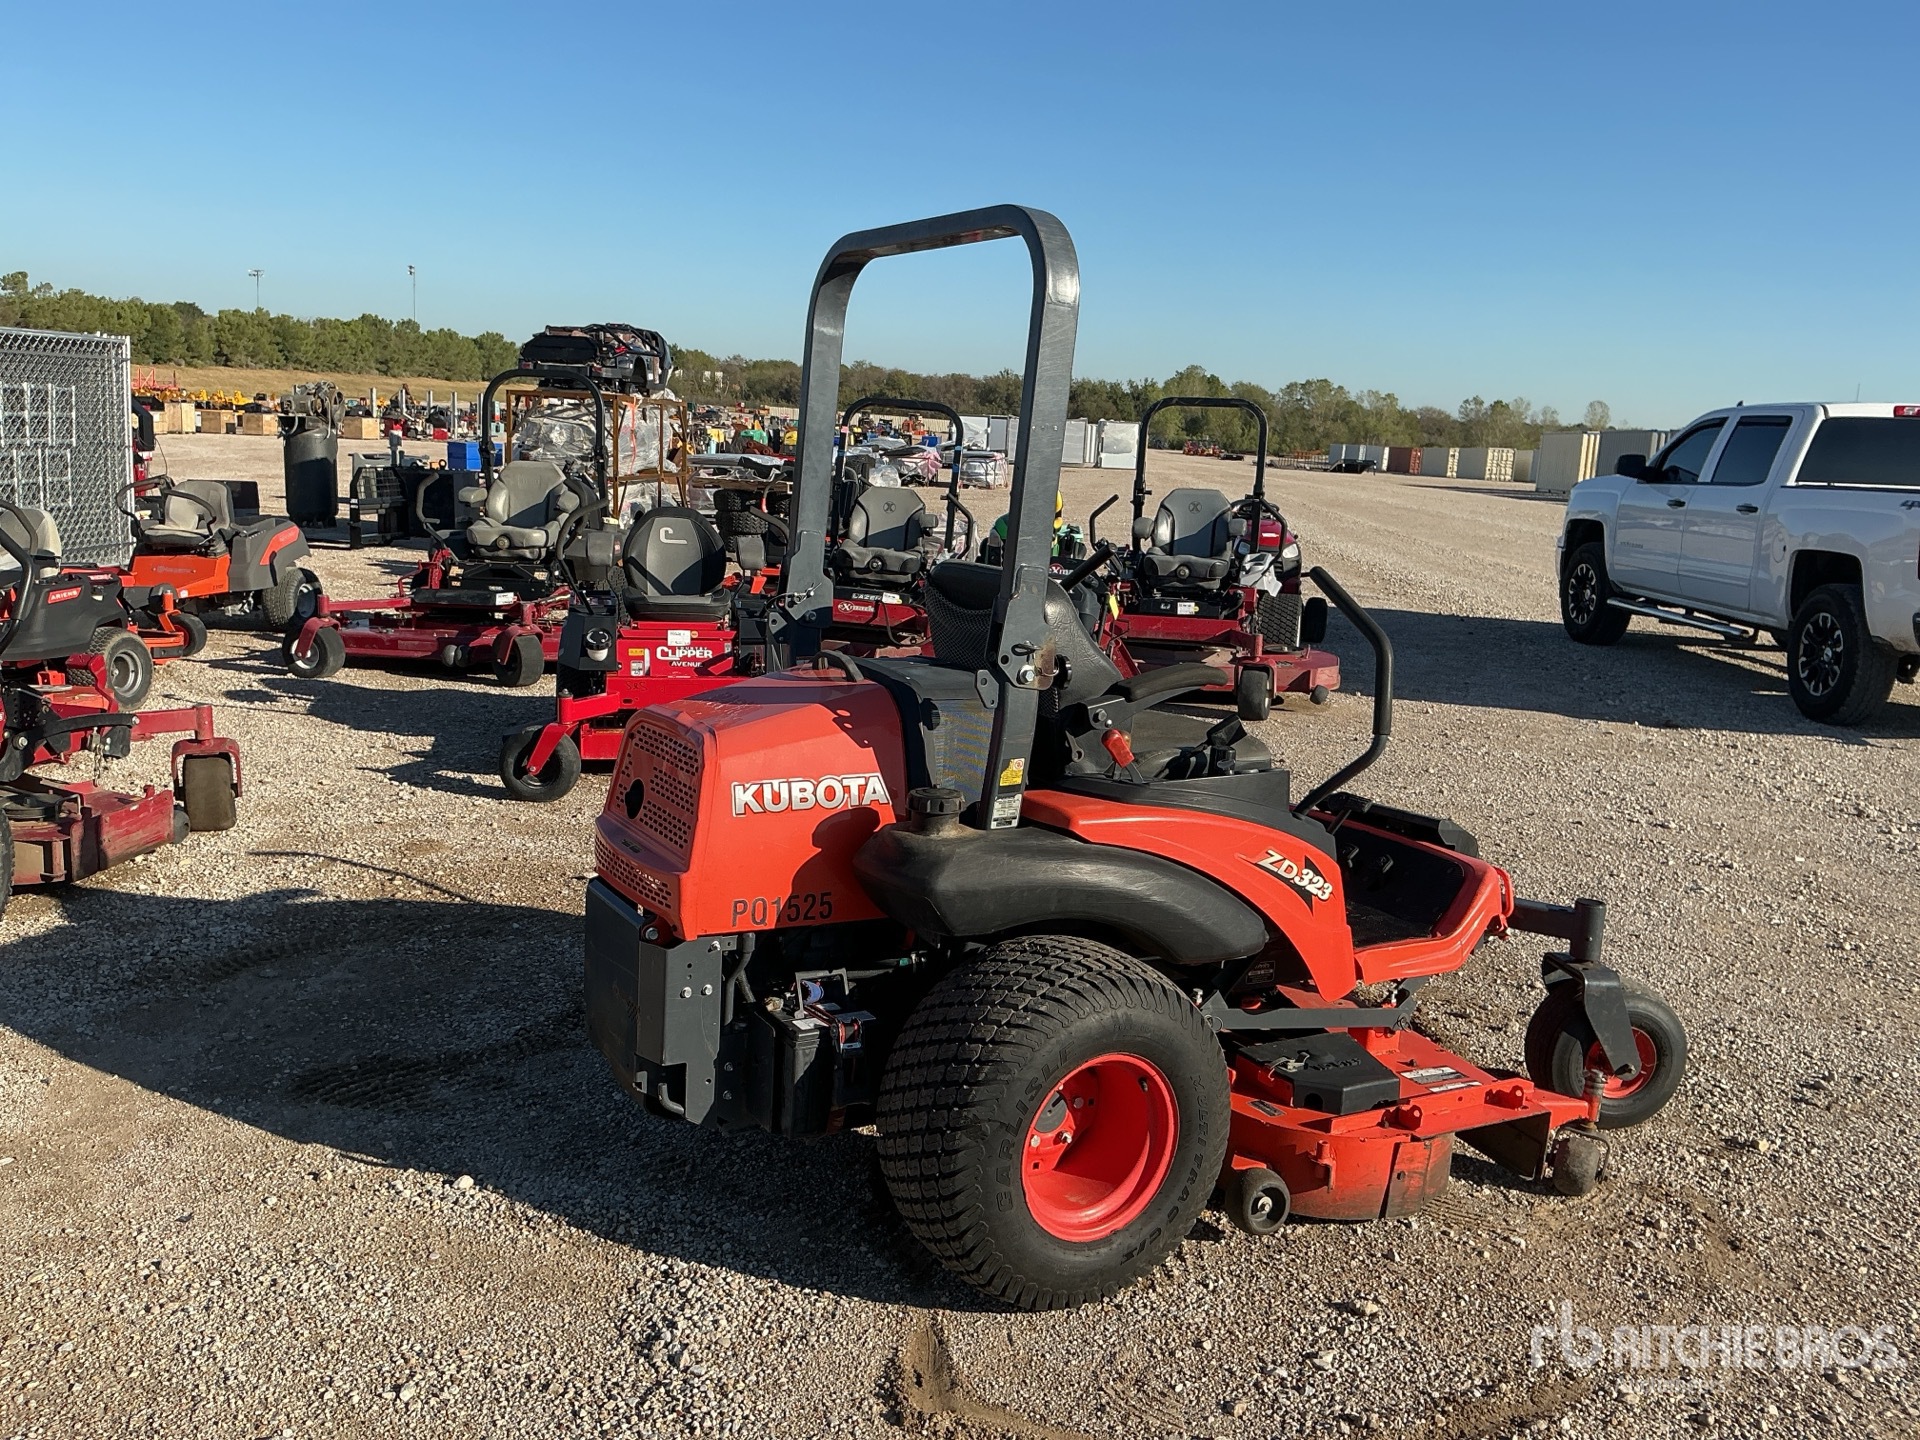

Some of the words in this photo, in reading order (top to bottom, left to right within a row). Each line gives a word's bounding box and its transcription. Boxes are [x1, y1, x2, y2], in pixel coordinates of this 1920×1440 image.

[50, 590, 78, 600] ARIENS
[656, 646, 713, 660] CLIPPER
[731, 773, 892, 817] KUBOTA
[732, 892, 833, 927] PQ1525
[995, 1040, 1077, 1213] CARLISLE
[1167, 1152, 1205, 1224] TRAC
